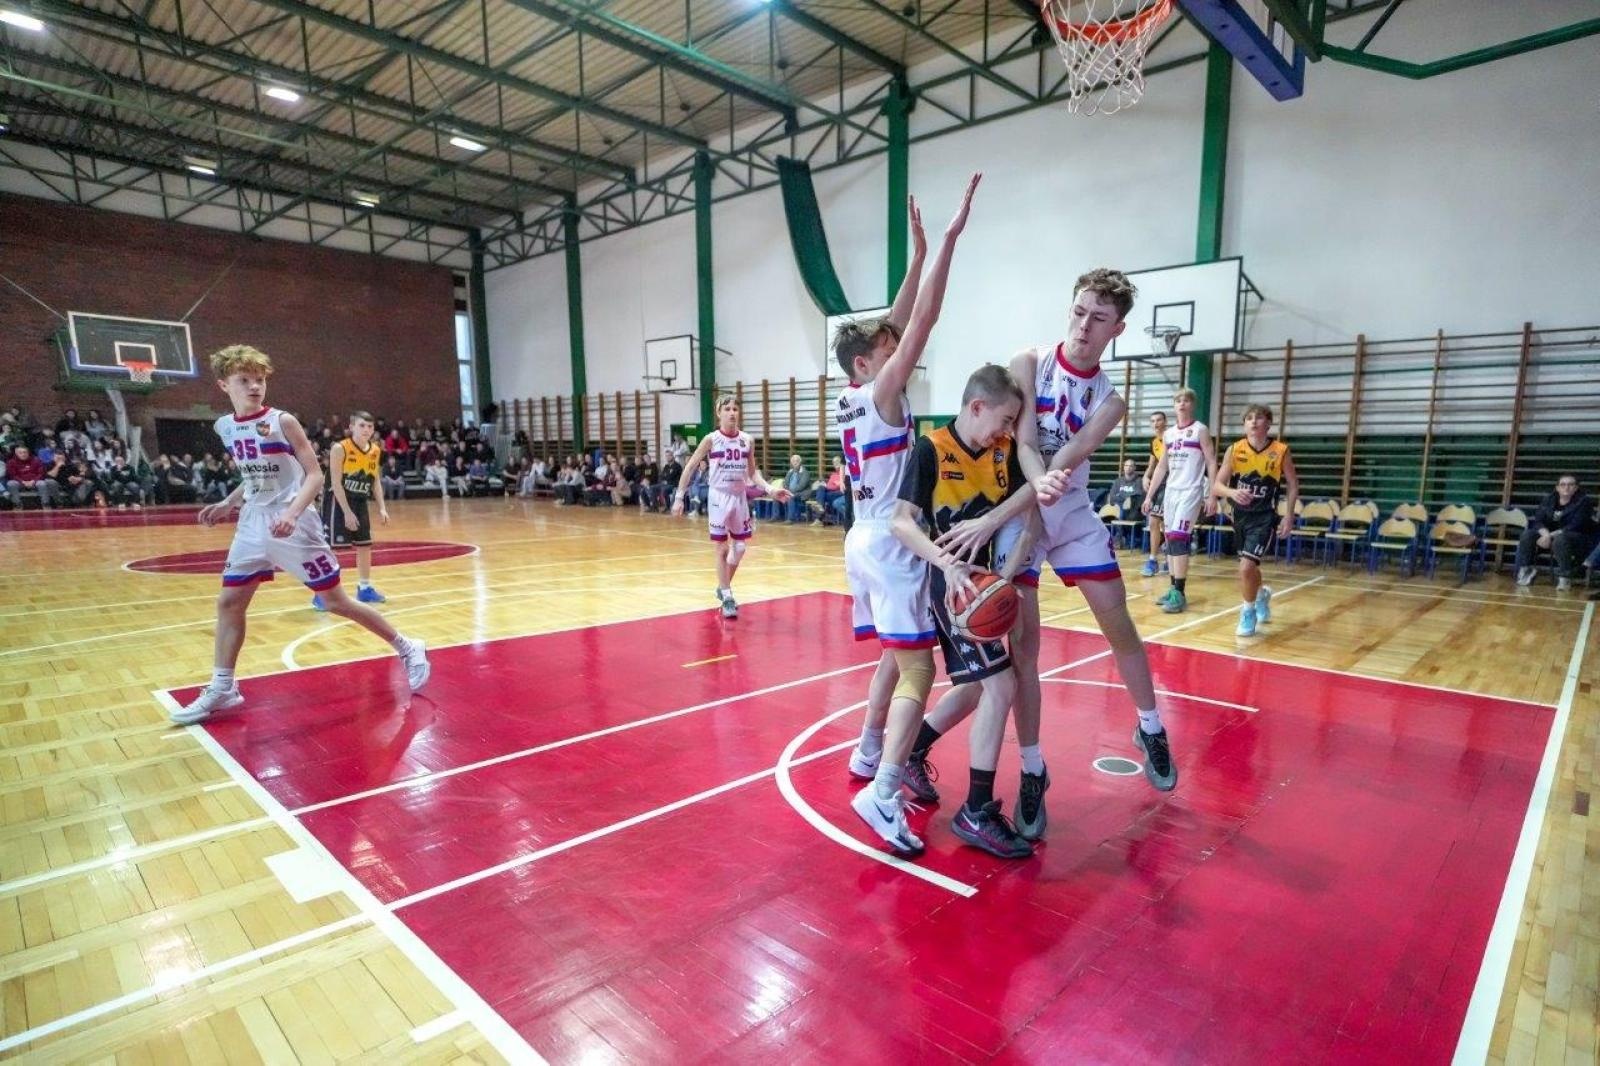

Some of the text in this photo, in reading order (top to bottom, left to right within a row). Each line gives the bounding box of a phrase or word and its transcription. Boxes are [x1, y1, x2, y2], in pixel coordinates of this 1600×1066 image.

[234, 438, 257, 460] 35
[725, 448, 740, 461] 30
[843, 427, 861, 481] 5
[368, 462, 376, 470] 10
[1265, 461, 1275, 471] 14
[302, 555, 333, 580] 35
